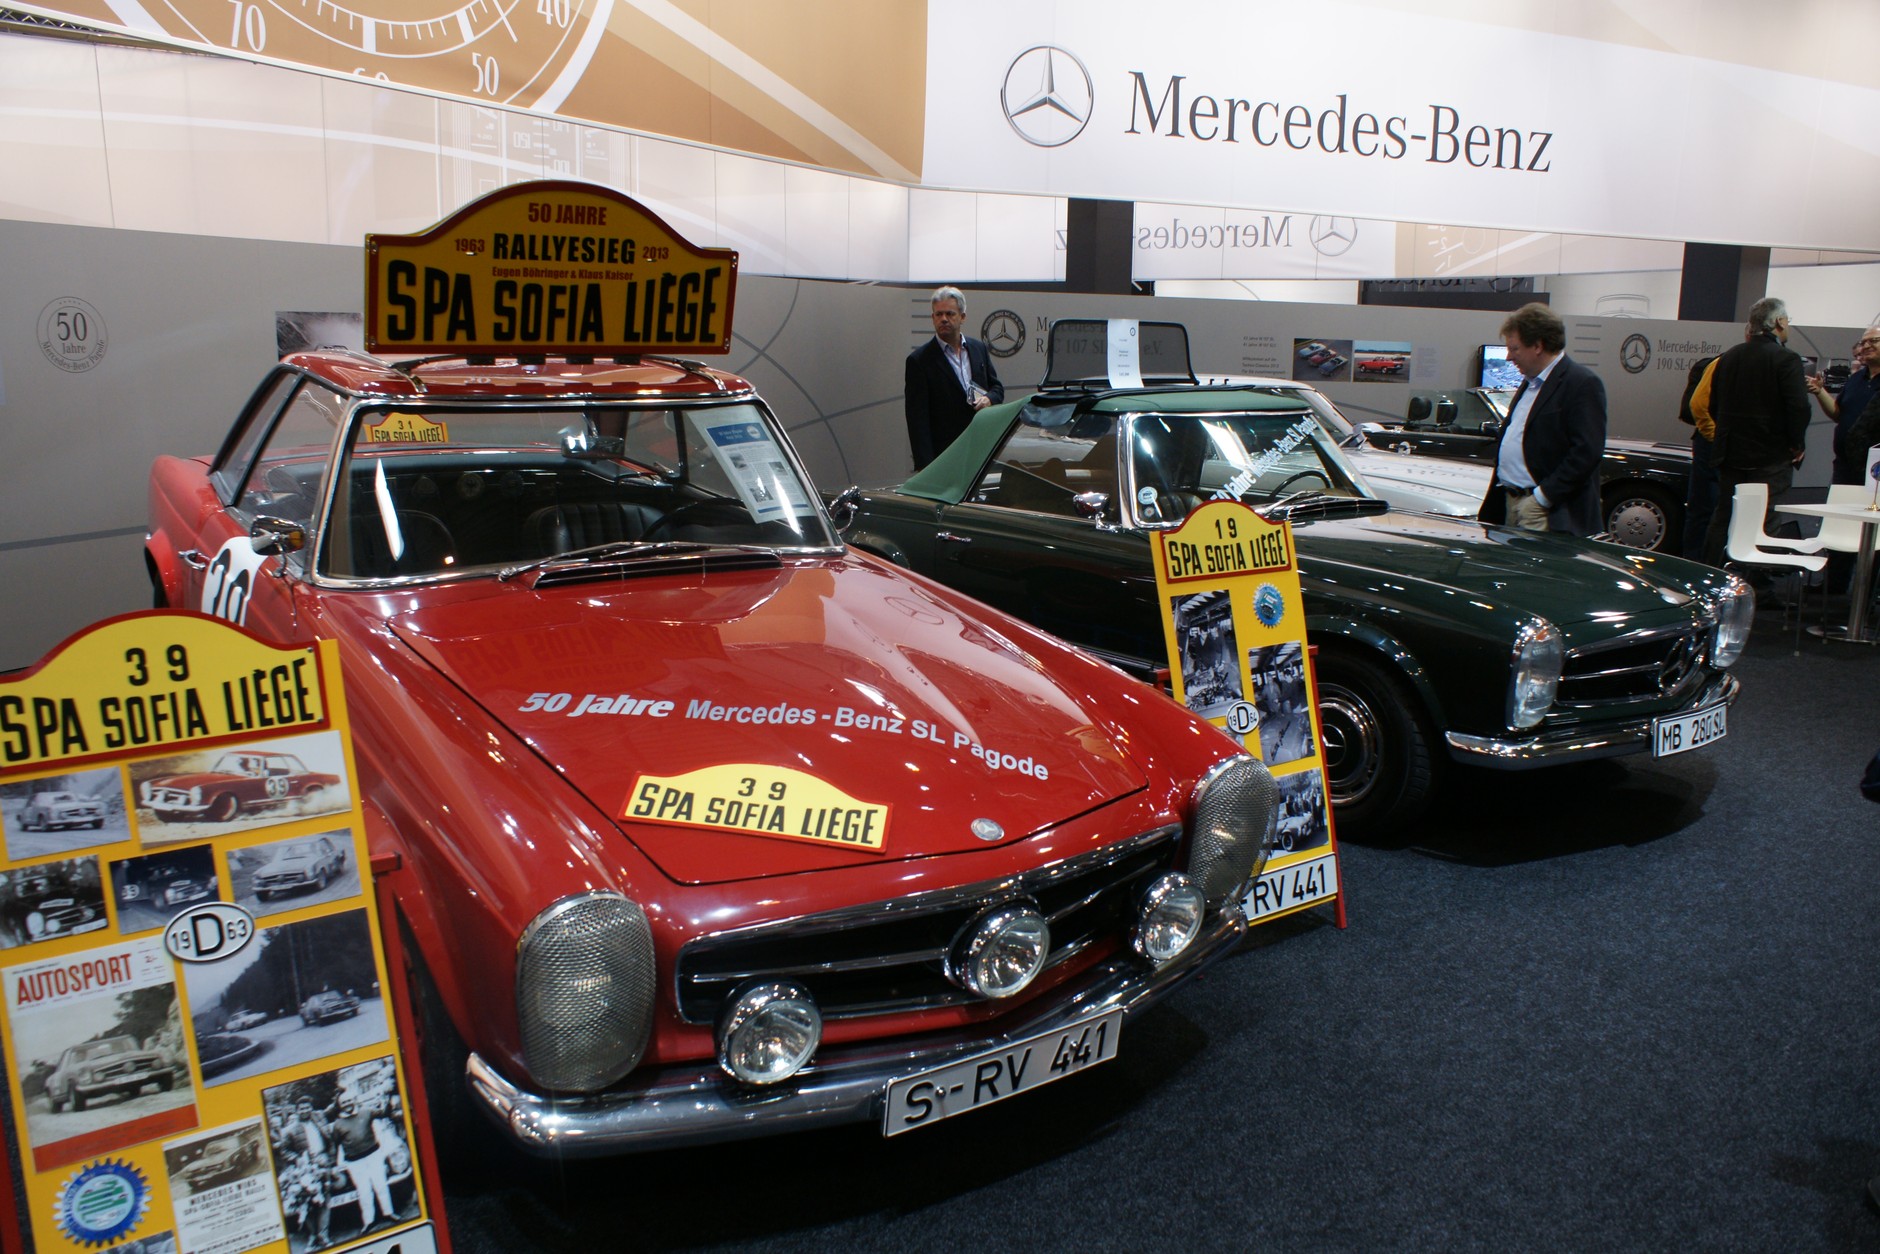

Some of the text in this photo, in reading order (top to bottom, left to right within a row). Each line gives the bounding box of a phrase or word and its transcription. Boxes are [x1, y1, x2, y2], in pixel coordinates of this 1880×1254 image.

[228, 0, 266, 52] 70
[471, 52, 499, 96] 50
[1124, 70, 1554, 173] Mercedes-Benz
[528, 202, 607, 226] 50 JAHRE
[454, 239, 485, 254] 1963
[493, 233, 636, 265] RALLYESIEG
[642, 246, 670, 260] 2013
[492, 266, 634, 281] Eugen Böhringer & Klaus Kaiser
[387, 259, 477, 342] SPA
[493, 280, 605, 343] SOFIA
[57, 312, 88, 342] 50
[62, 342, 87, 355] Jahre
[1656, 357, 1673, 371] 190
[1657, 339, 1722, 355] Mercedes-Benz
[1168, 540, 1203, 577] SPA
[1205, 542, 1247, 573] SOFIA
[0, 695, 89, 762] SPA
[100, 687, 210, 748] SOFIA
[518, 692, 572, 712] 50
[567, 693, 675, 717] Jahre
[910, 719, 947, 745] SL
[953, 731, 1050, 781] Pagode
[1236, 706, 1250, 731] D
[1662, 723, 1682, 753] MB
[633, 782, 696, 820] SPA
[704, 797, 786, 834] SOFIA
[1292, 863, 1326, 900] 441
[172, 930, 191, 952] 19
[190, 912, 226, 957] D
[227, 919, 248, 940] 63
[17, 953, 132, 1006] AUTOSPORT
[1050, 1021, 1108, 1073] 441
